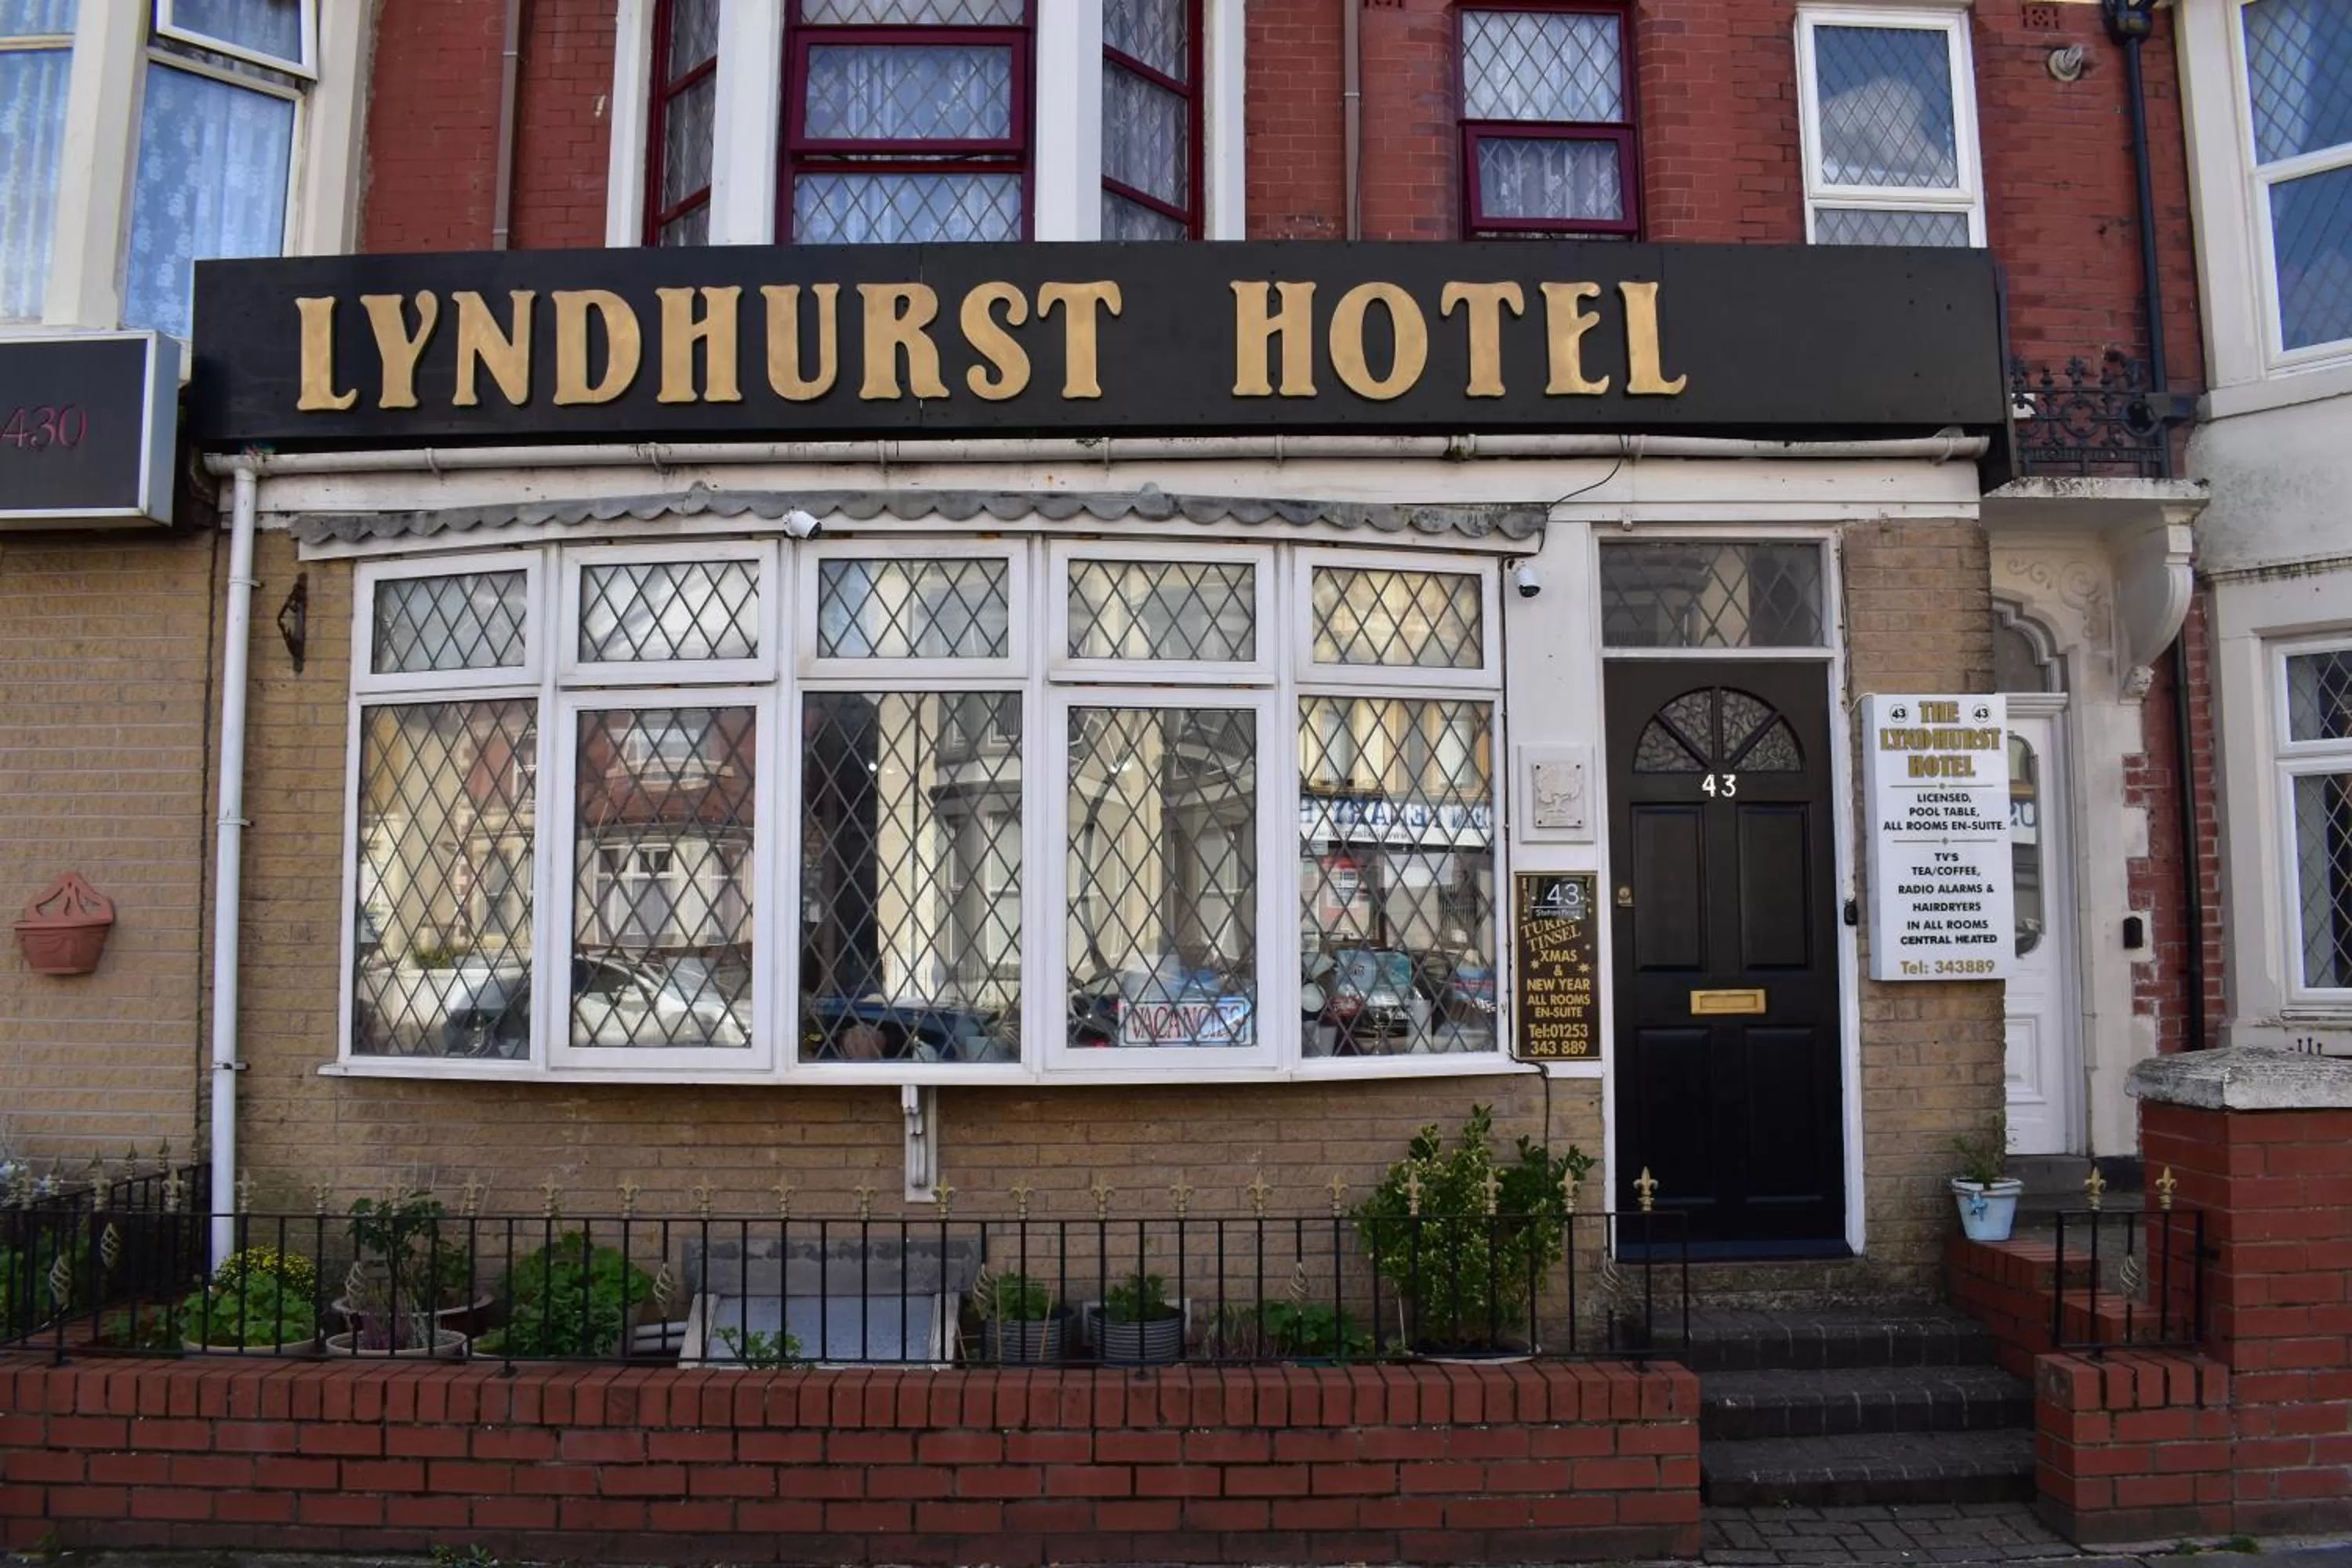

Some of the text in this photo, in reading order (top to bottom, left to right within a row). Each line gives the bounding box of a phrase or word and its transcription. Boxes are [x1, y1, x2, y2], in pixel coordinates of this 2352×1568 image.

[296, 280, 1687, 411] LYNDHURST HOTEL
[1891, 708, 1907, 720] 43
[1918, 700, 1960, 724] THE
[1973, 707, 1990, 720] 43
[1879, 728, 2002, 750] LYNDHURST
[1907, 754, 1976, 779] HOTEL
[1702, 774, 1737, 797] 43
[1916, 793, 1973, 804] LICENSED,
[1908, 806, 1980, 818] POOL TABLE,
[1882, 820, 2006, 831] ALL ROOMS EN-SUITE.
[1934, 851, 1959, 862] TV'S
[1911, 866, 1981, 877] TEA/COFFEE,
[1546, 883, 1580, 906] 43
[1898, 884, 1994, 895] RADIO ALARMS &
[1911, 902, 1982, 913] HAIRDRYERS
[1907, 919, 1990, 931] IN ALL ROOMS
[1526, 925, 1581, 953] TINSEL
[1900, 934, 1998, 946] CENTRAL HEATED
[1540, 949, 1578, 963] XMAS
[1553, 964, 1563, 977] &
[1900, 960, 1995, 975] Tel: 343889
[1526, 978, 1591, 992] NEW YEAR
[1526, 993, 1591, 1006] ALL ROOMS
[1534, 1007, 1584, 1018] EN-SUITE
[1530, 1040, 1588, 1055] 343 889
